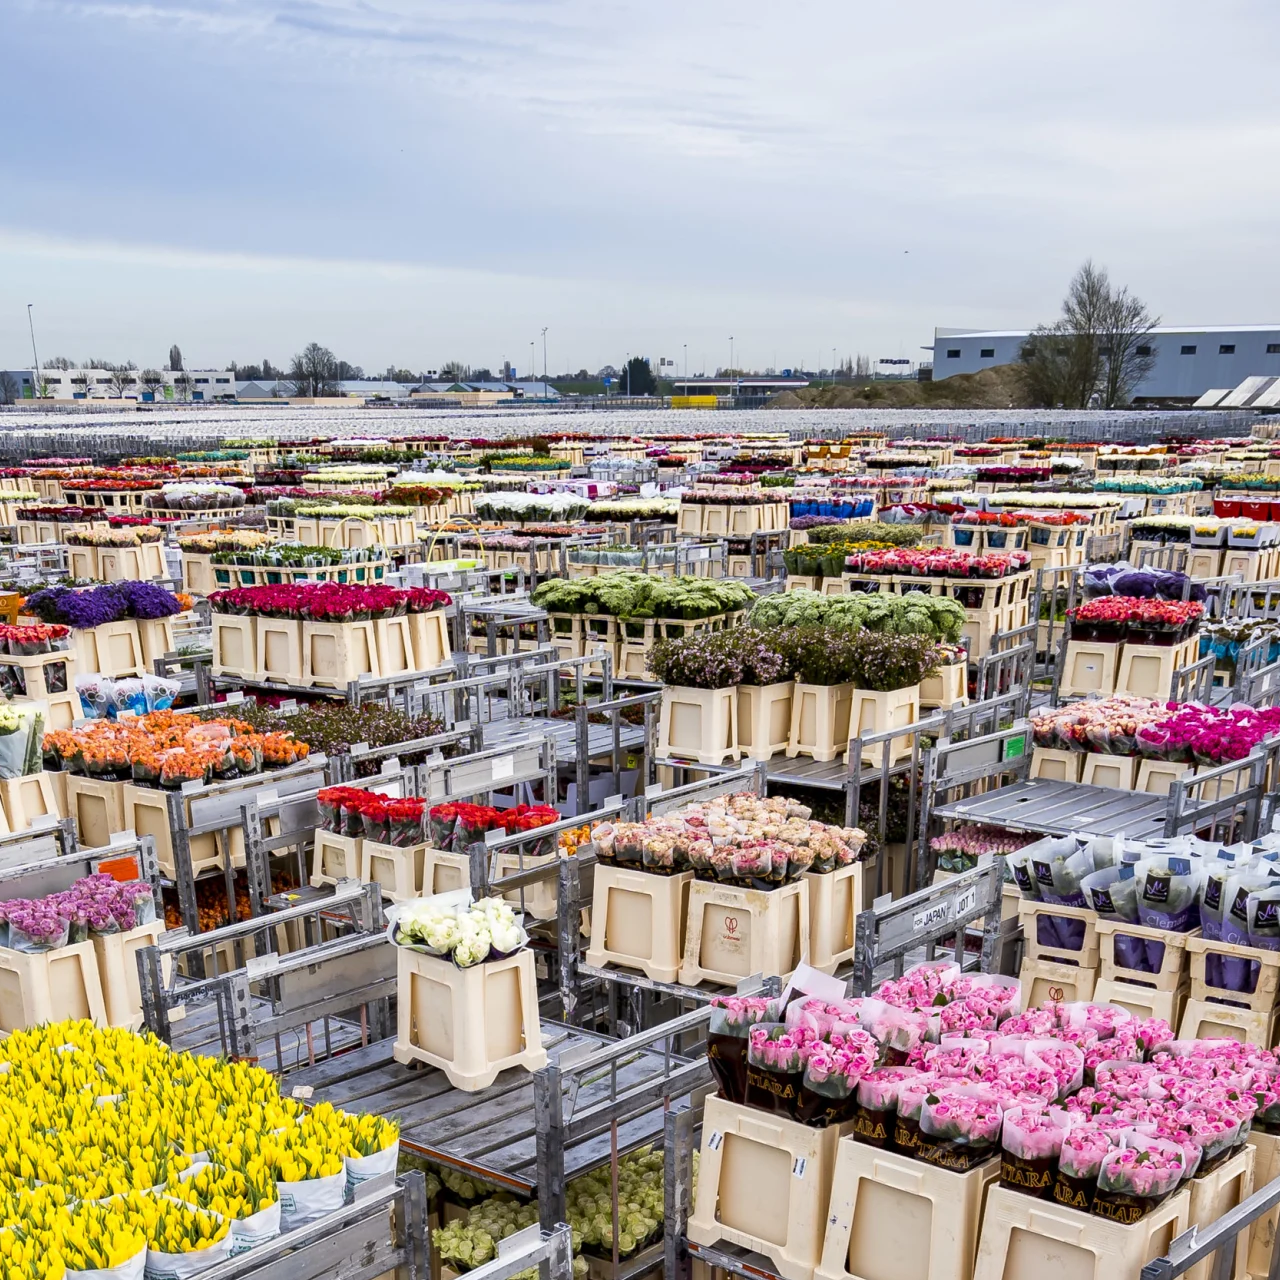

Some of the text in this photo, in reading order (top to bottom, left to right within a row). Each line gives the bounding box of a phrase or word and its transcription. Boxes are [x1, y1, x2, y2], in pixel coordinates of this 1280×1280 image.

[923, 906, 947, 926] JAPAN
[747, 1069, 796, 1099] TIARA
[854, 1117, 888, 1139] ARA
[917, 1140, 970, 1169] TIARA
[1000, 1162, 1054, 1188] TIARA
[1053, 1182, 1089, 1208] ARA
